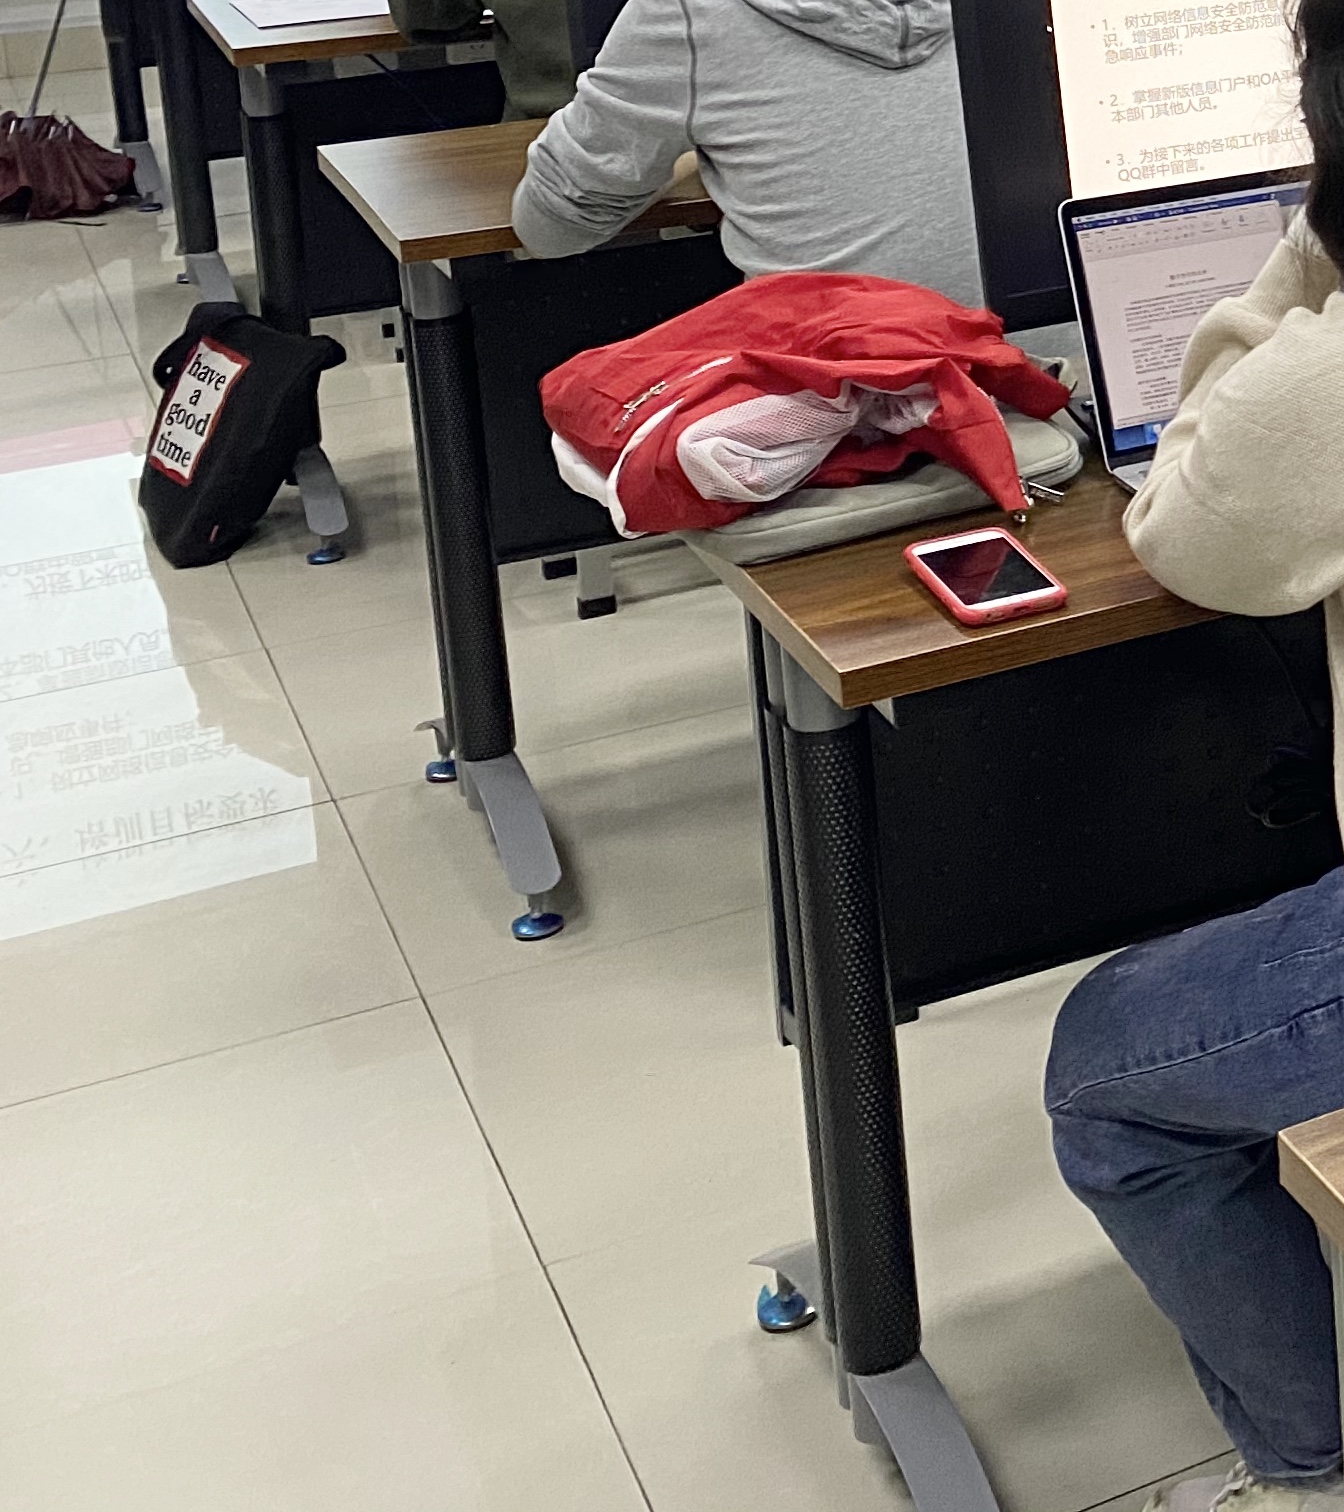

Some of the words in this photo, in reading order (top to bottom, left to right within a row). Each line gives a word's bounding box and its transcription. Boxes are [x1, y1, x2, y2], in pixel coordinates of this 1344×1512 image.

[188, 354, 228, 392] have
[190, 388, 202, 407] a
[164, 402, 211, 439] good
[156, 432, 193, 470] time
